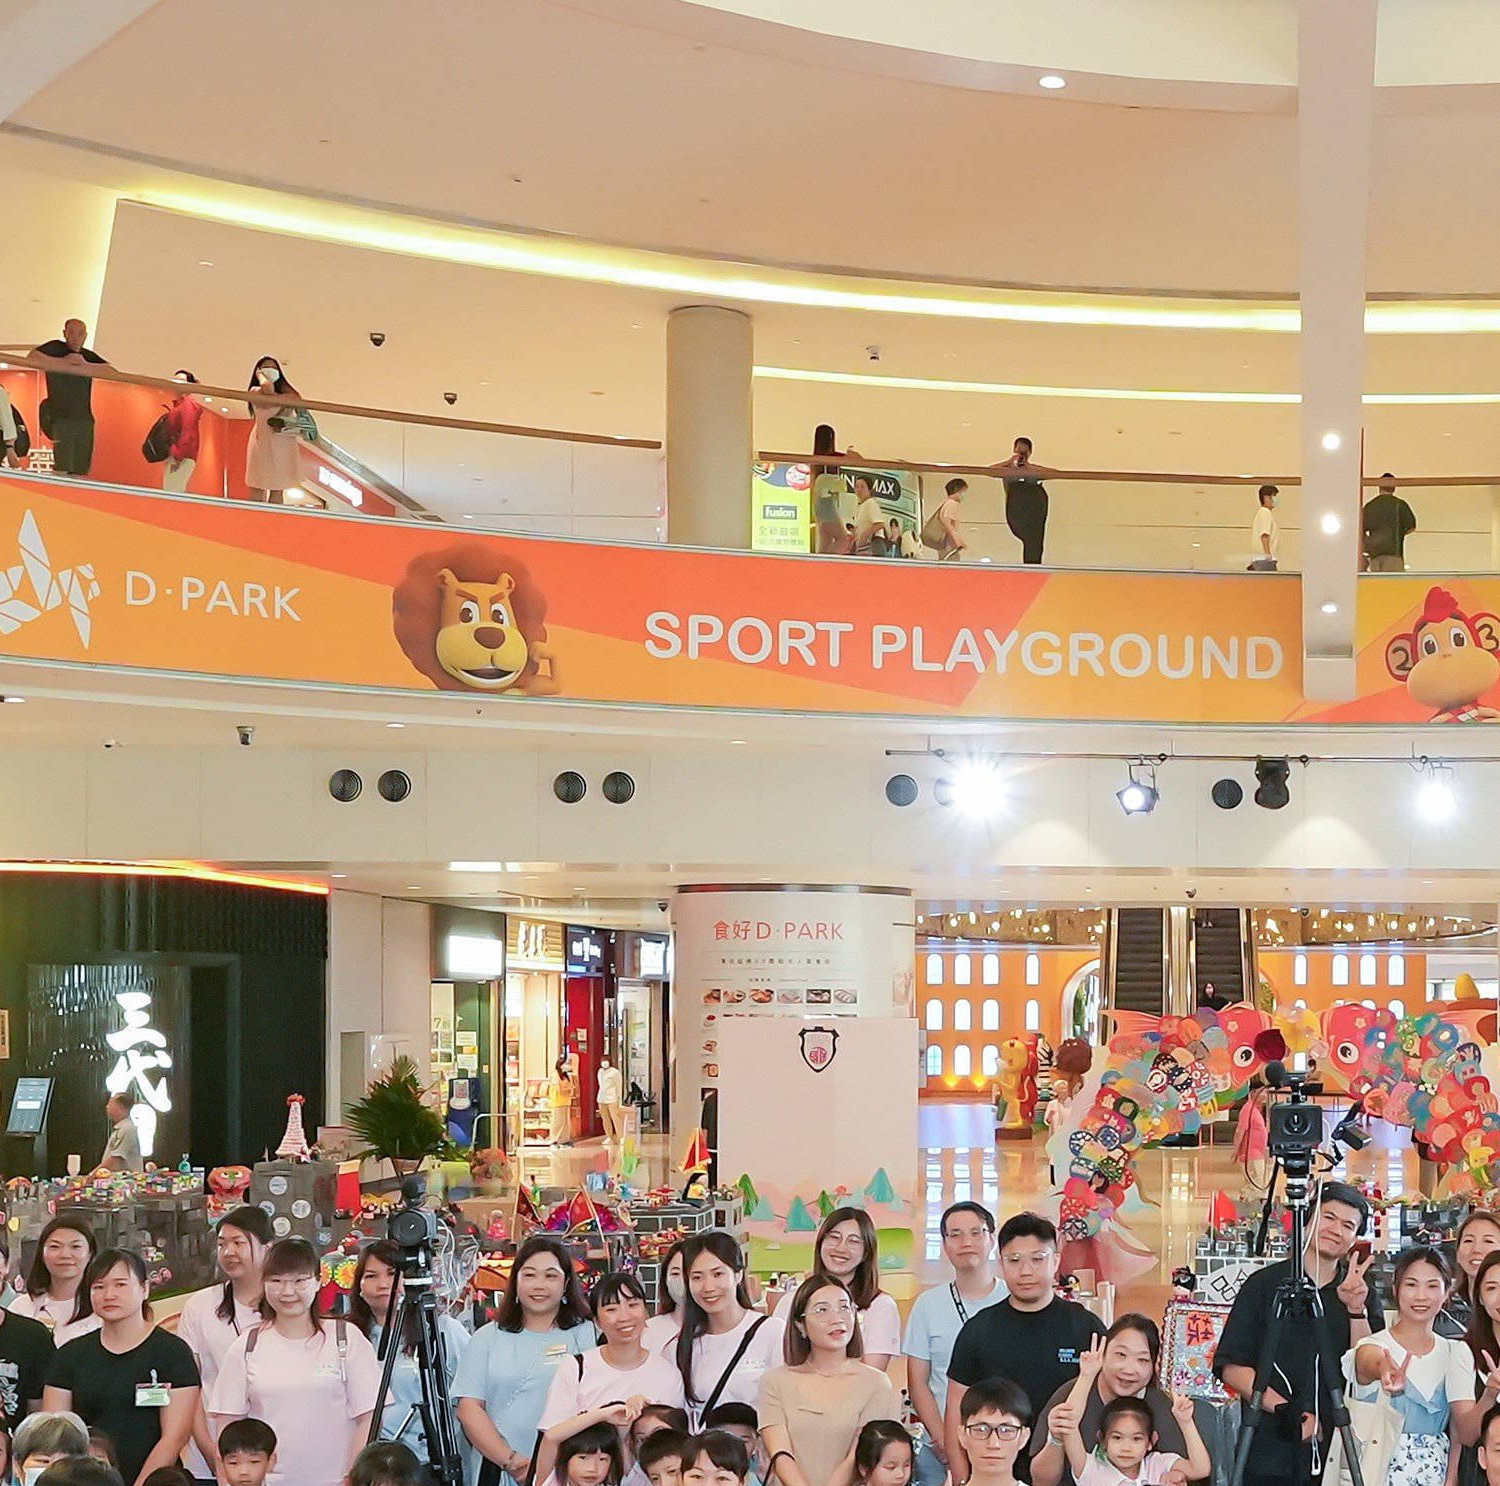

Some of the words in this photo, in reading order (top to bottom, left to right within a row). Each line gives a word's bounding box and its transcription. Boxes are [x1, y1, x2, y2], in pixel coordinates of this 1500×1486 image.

[765, 508, 796, 519] fusion
[645, 609, 855, 667] SPORT
[871, 624, 1284, 682] PLAYGROUND
[713, 920, 751, 941] 食好
